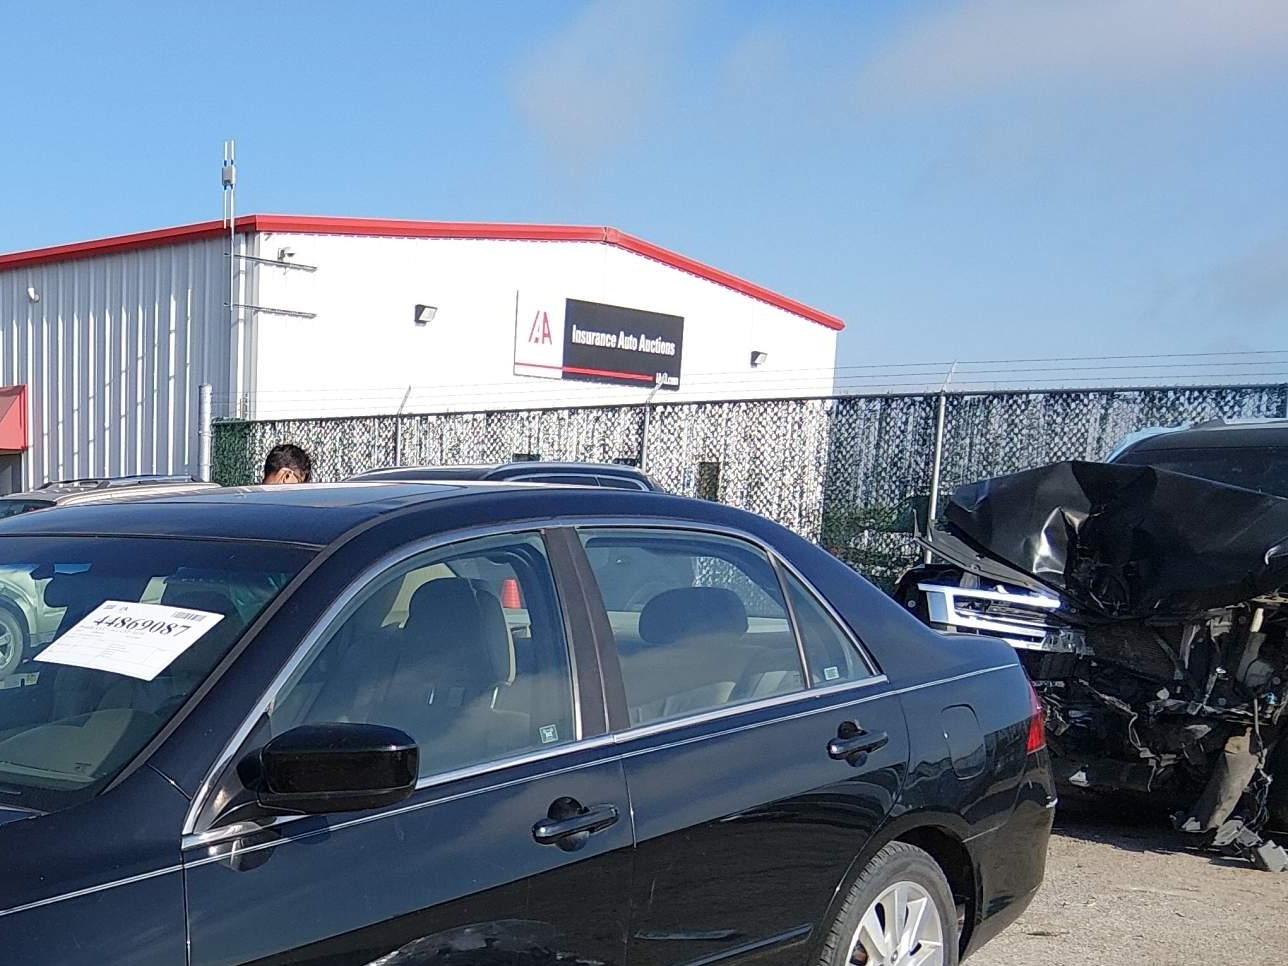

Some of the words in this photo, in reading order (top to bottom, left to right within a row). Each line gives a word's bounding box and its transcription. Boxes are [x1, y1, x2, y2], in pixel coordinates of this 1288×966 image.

[572, 323, 617, 348] Insurance
[617, 330, 638, 351] Auto
[638, 333, 676, 356] Auctions
[94, 614, 191, 637] 44869087
